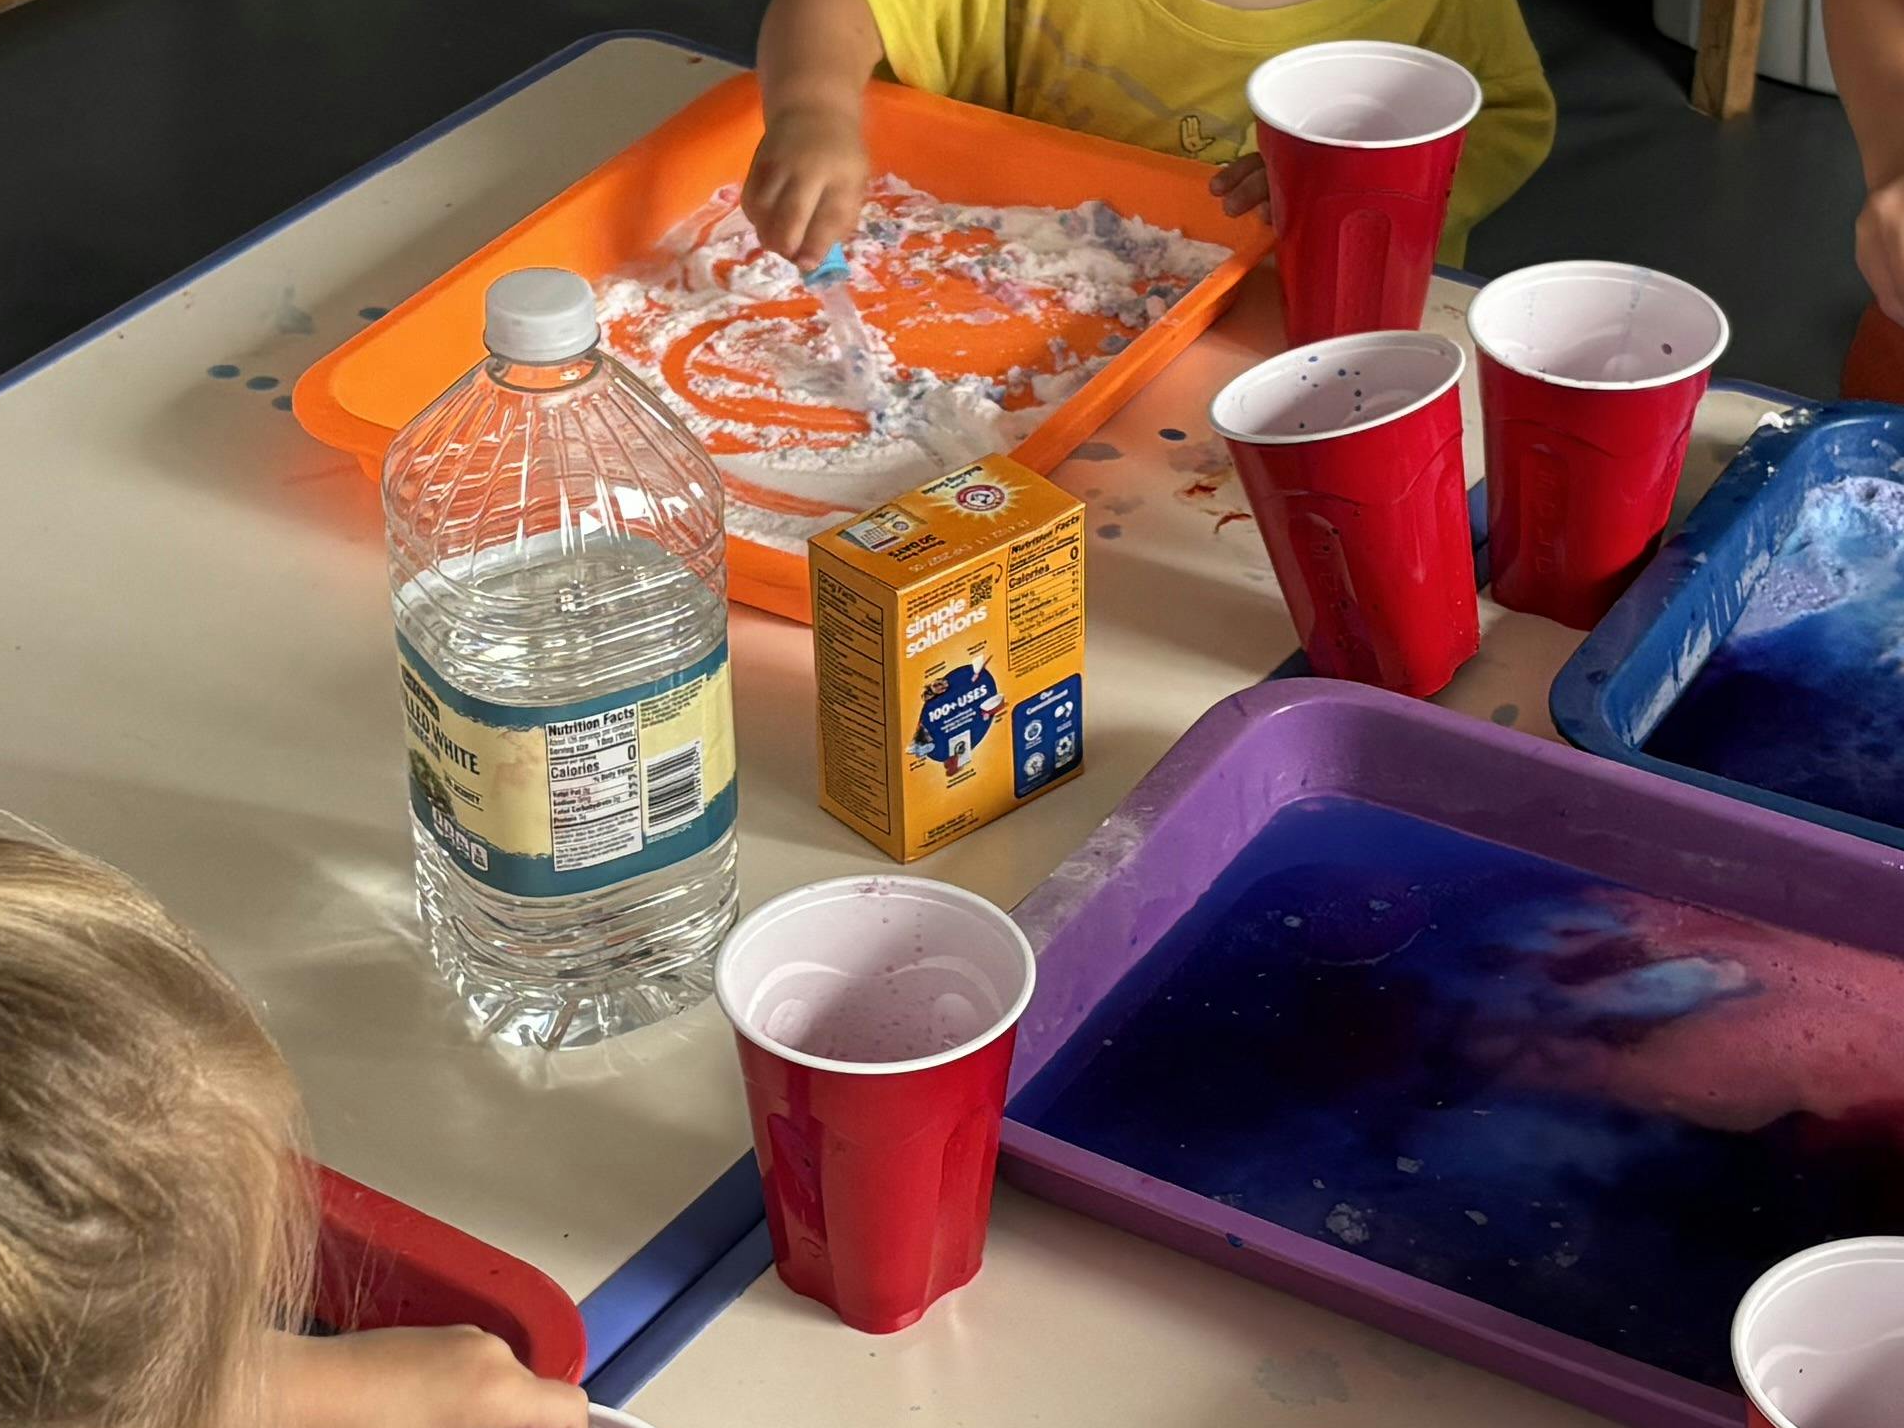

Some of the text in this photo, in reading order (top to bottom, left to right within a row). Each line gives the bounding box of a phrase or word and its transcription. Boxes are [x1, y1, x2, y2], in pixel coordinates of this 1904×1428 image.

[1011, 529, 1053, 555] Nutrition
[1055, 514, 1080, 534] Facts
[1069, 545, 1079, 561] 0
[1008, 563, 1050, 589] Calories
[906, 599, 966, 639] simple
[906, 606, 988, 658] solutions
[548, 707, 635, 737] Nutrition Facts
[431, 721, 481, 776] WHITE
[551, 744, 637, 779] Calories 0
